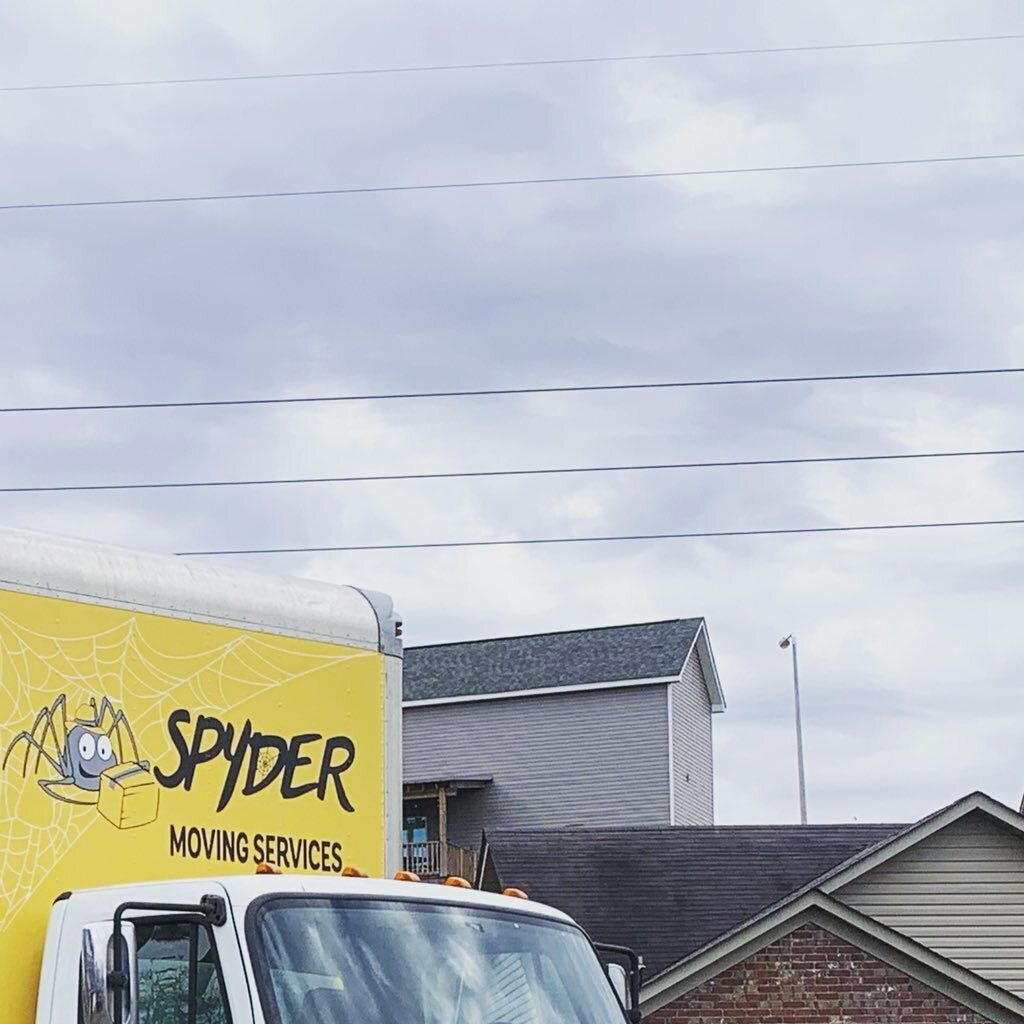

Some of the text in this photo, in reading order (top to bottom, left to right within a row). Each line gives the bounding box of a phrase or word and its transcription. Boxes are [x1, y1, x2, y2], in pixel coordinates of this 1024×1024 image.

[153, 708, 356, 813] SPYDER
[170, 824, 343, 873] MOVING SERVICES
